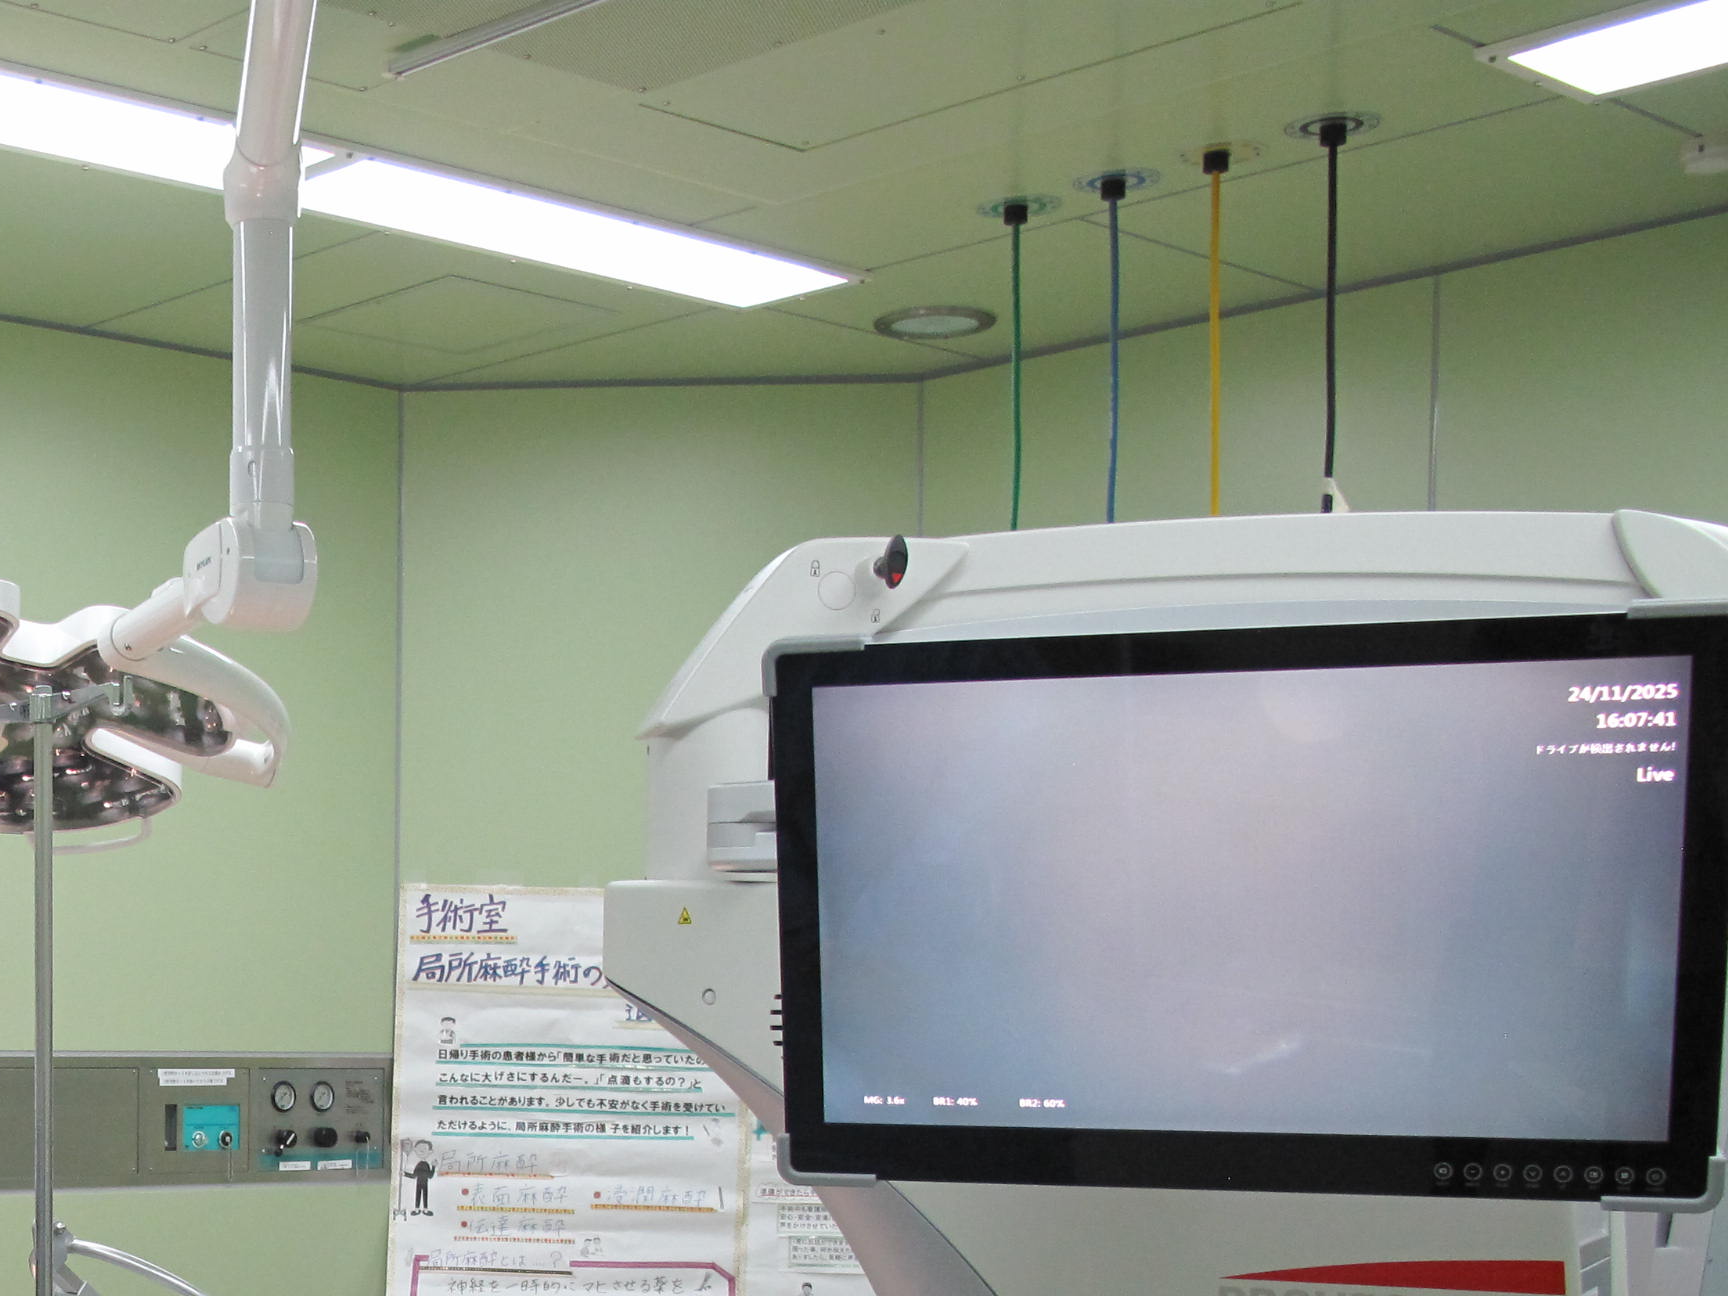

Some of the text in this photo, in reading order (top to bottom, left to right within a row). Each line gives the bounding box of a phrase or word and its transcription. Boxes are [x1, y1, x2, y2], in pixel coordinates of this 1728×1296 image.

[1568, 683, 1679, 703] 24/11/2025
[1596, 711, 1677, 729] 16:07:41
[1636, 767, 1675, 783] Live
[415, 893, 510, 936] 手術室
